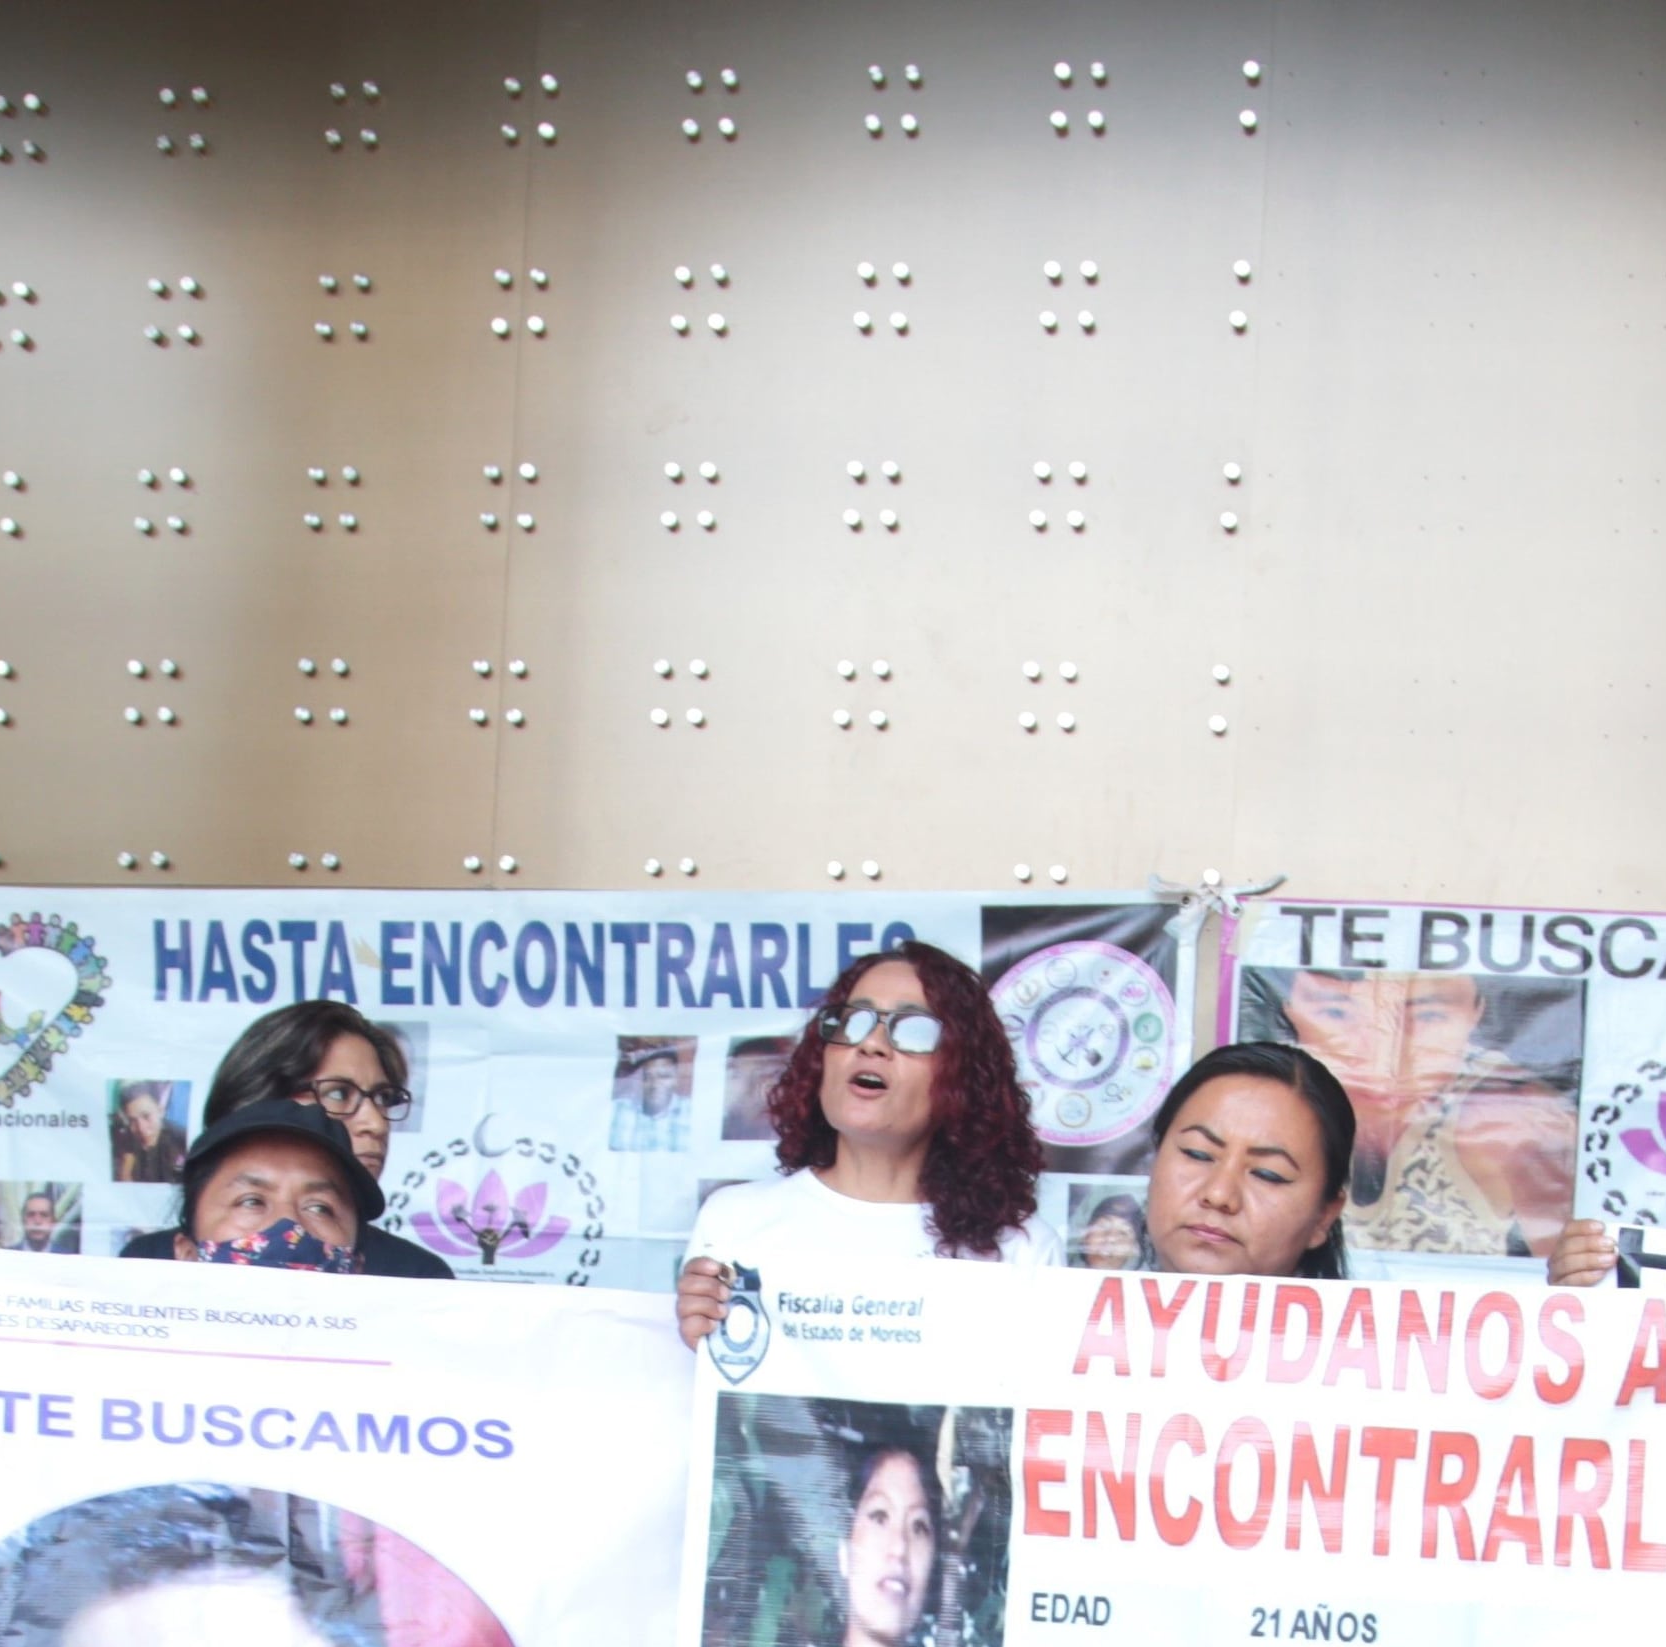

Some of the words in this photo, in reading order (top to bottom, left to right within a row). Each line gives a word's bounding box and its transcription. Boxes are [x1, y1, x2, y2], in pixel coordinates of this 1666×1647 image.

[152, 918, 360, 1004] HASTA
[1280, 905, 1390, 969] TE
[6, 1295, 84, 1313] FAMILIAS
[91, 1300, 199, 1322] RESILIENTES
[205, 1306, 301, 1328] BUSCANDO
[306, 1314, 319, 1329] A
[323, 1315, 358, 1331] SUS
[26, 1316, 170, 1339] DESAPARECIDOS
[851, 1295, 924, 1318] General
[798, 1324, 844, 1342] Estado
[848, 1325, 865, 1343] de
[869, 1326, 922, 1344] Morelos
[1071, 1276, 1587, 1406] AYUDANOS
[100, 1397, 515, 1460] BUSCAMOS
[1029, 1592, 1112, 1628] EDAD
[1249, 1606, 1284, 1639] 21
[1290, 1602, 1379, 1644] AÑOS
